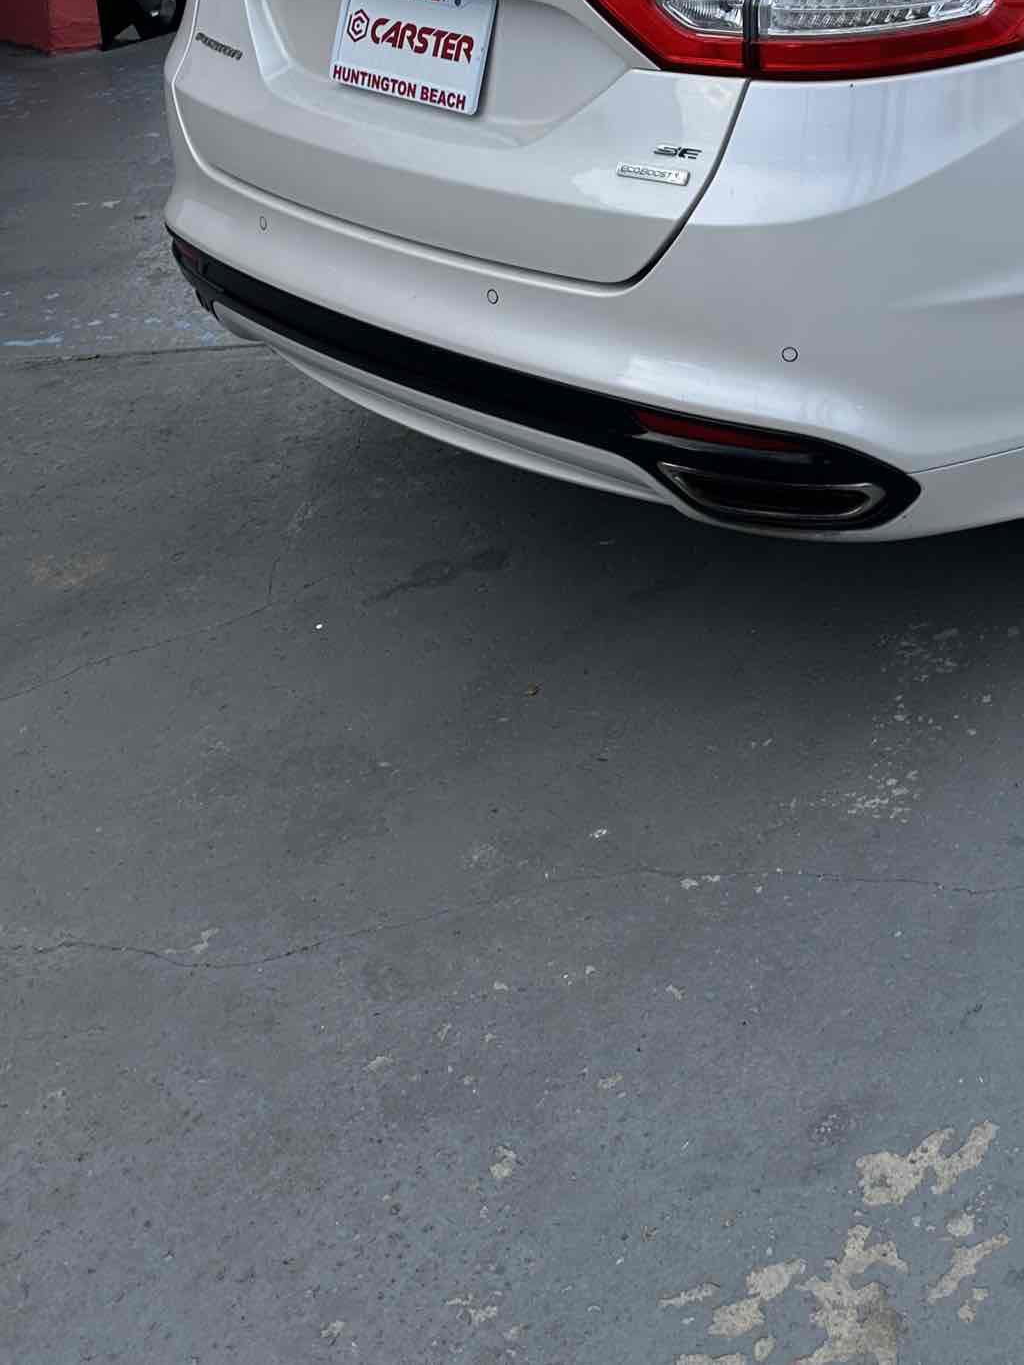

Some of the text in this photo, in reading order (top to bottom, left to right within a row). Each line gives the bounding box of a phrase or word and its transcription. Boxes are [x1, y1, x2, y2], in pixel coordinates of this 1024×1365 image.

[370, 17, 474, 64] CARSTER
[332, 65, 466, 111] HUNTINGTON BEACH
[653, 146, 702, 160] SE
